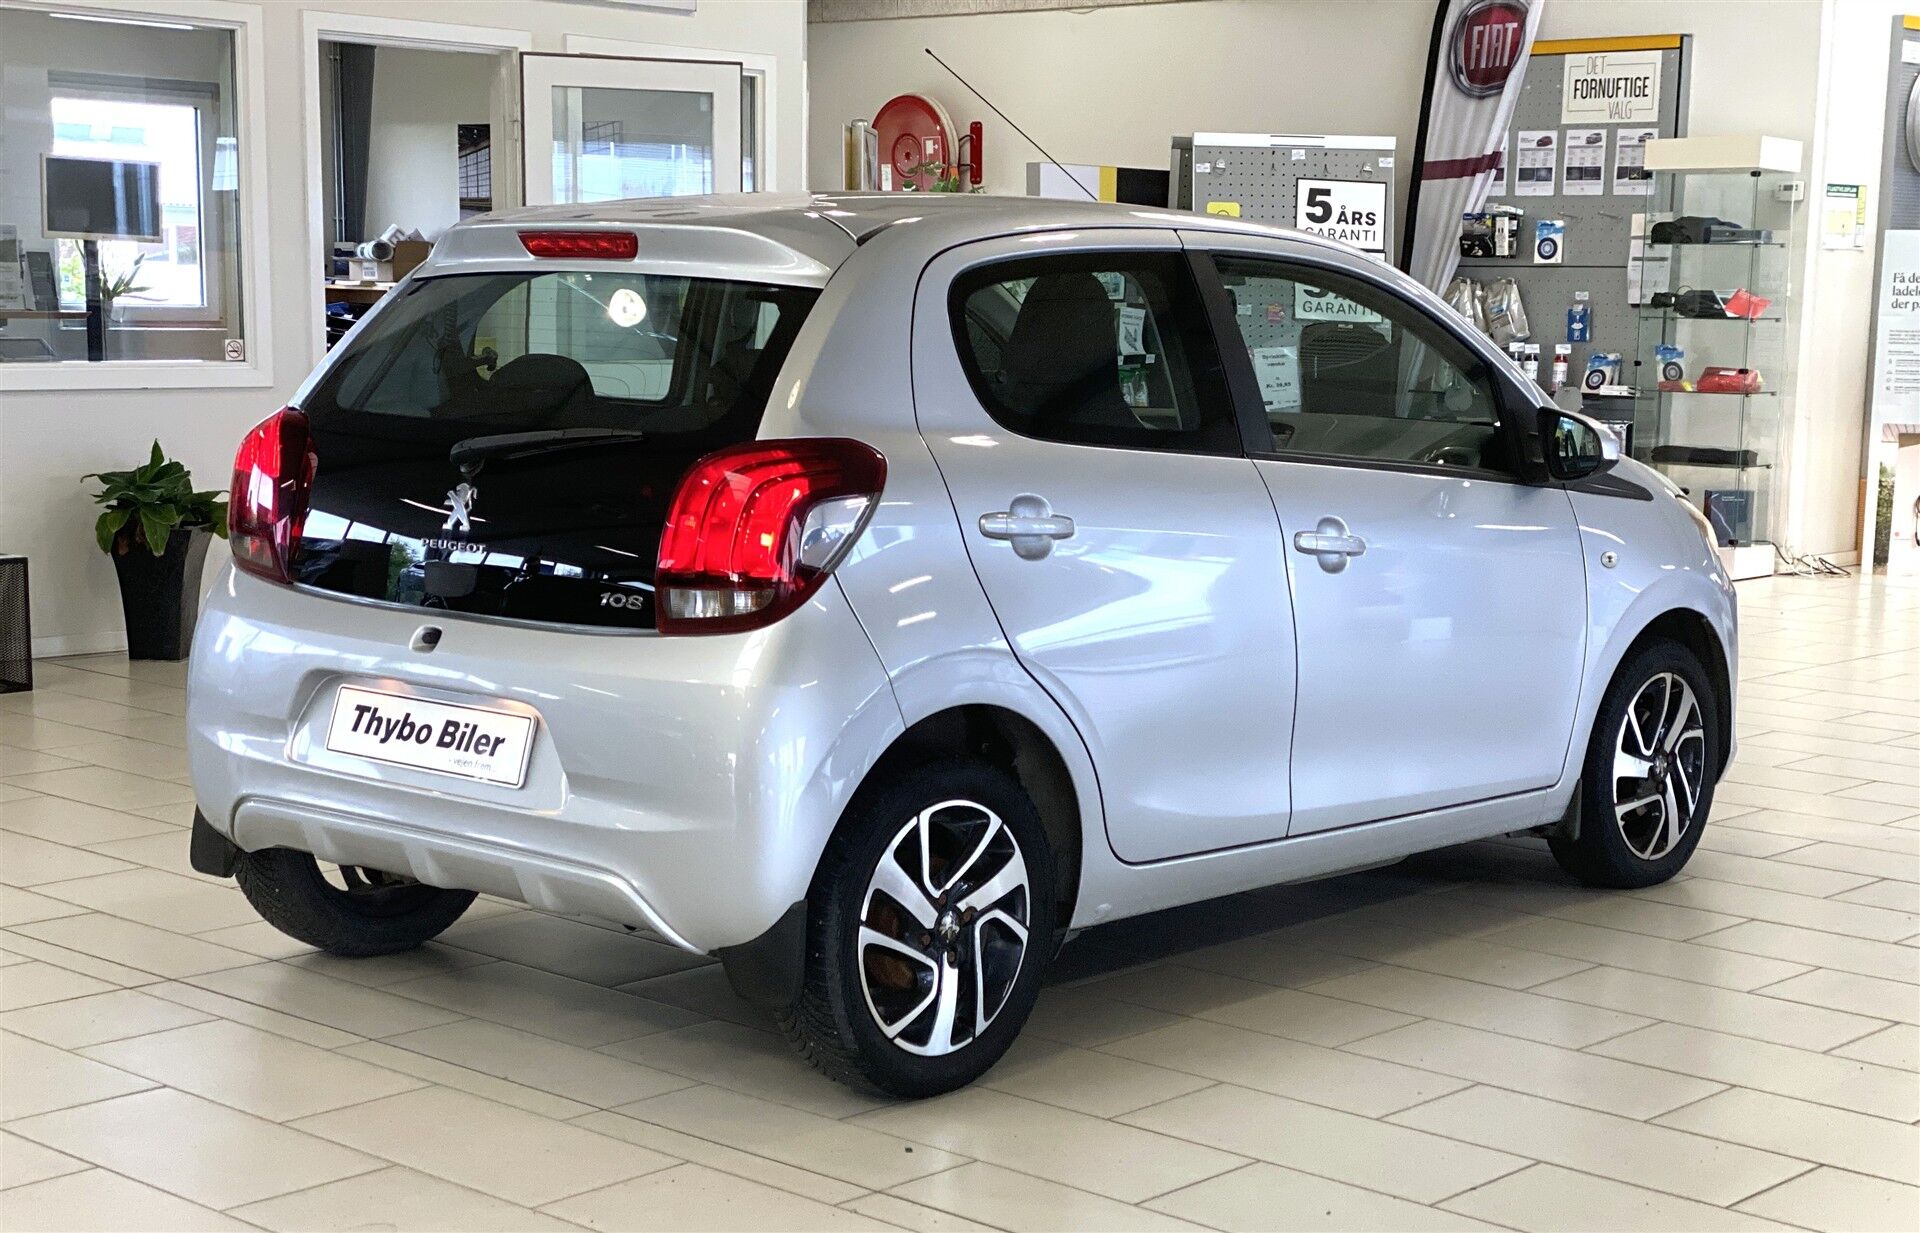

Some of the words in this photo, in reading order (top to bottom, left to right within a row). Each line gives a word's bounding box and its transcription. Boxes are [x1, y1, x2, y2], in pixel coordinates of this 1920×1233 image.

[1470, 22, 1518, 70] FIAT
[1586, 55, 1607, 75] DET
[1573, 76, 1650, 99] FORNUFTIGE
[1608, 100, 1632, 120] VALG
[1305, 187, 1333, 224] 5
[1336, 204, 1376, 226] ÅRS
[1893, 271, 1905, 283] Få
[1891, 298, 1909, 309] der
[421, 538, 487, 554] PEUGEOT
[600, 592, 643, 609] 108
[351, 704, 433, 744] Thybo
[436, 719, 506, 757] Biler
